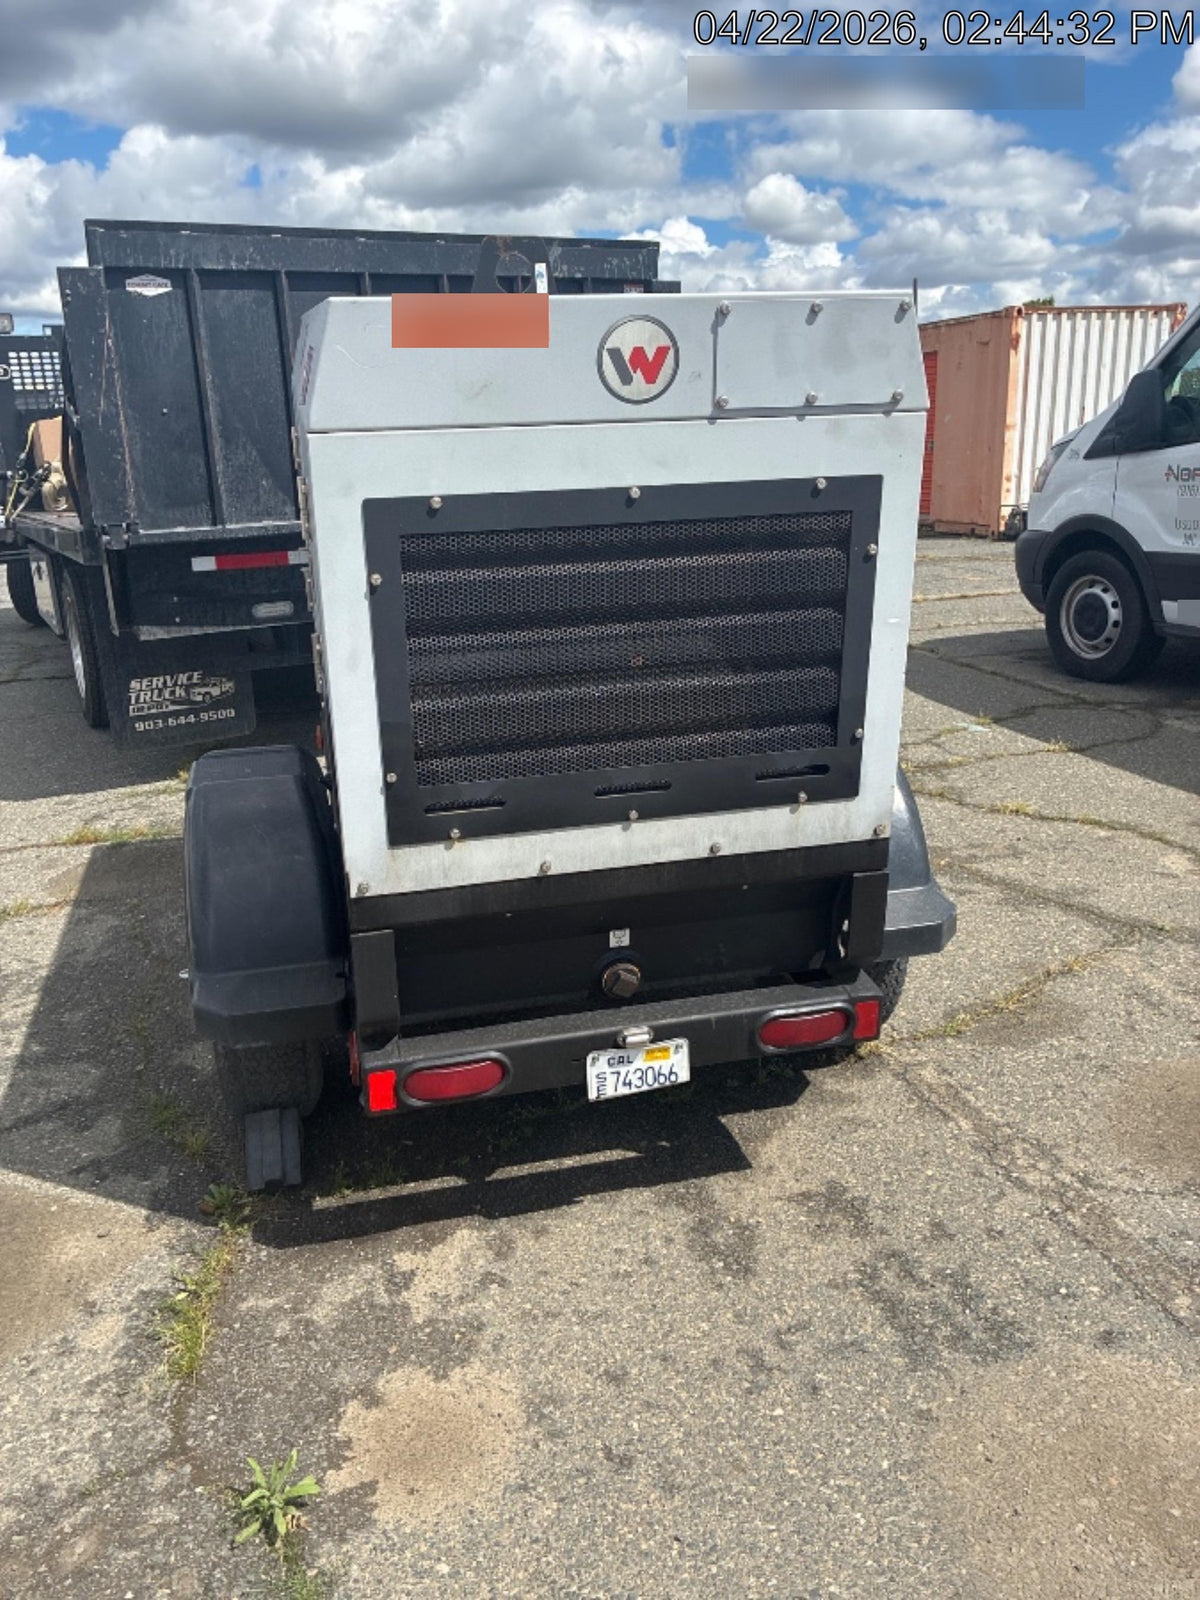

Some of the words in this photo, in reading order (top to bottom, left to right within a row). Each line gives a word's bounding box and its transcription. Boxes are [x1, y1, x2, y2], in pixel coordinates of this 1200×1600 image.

[129, 670, 203, 692] SERVICE
[128, 685, 188, 705] TRUCK
[608, 1055, 634, 1067] CAL
[610, 1063, 679, 1092] 743066
